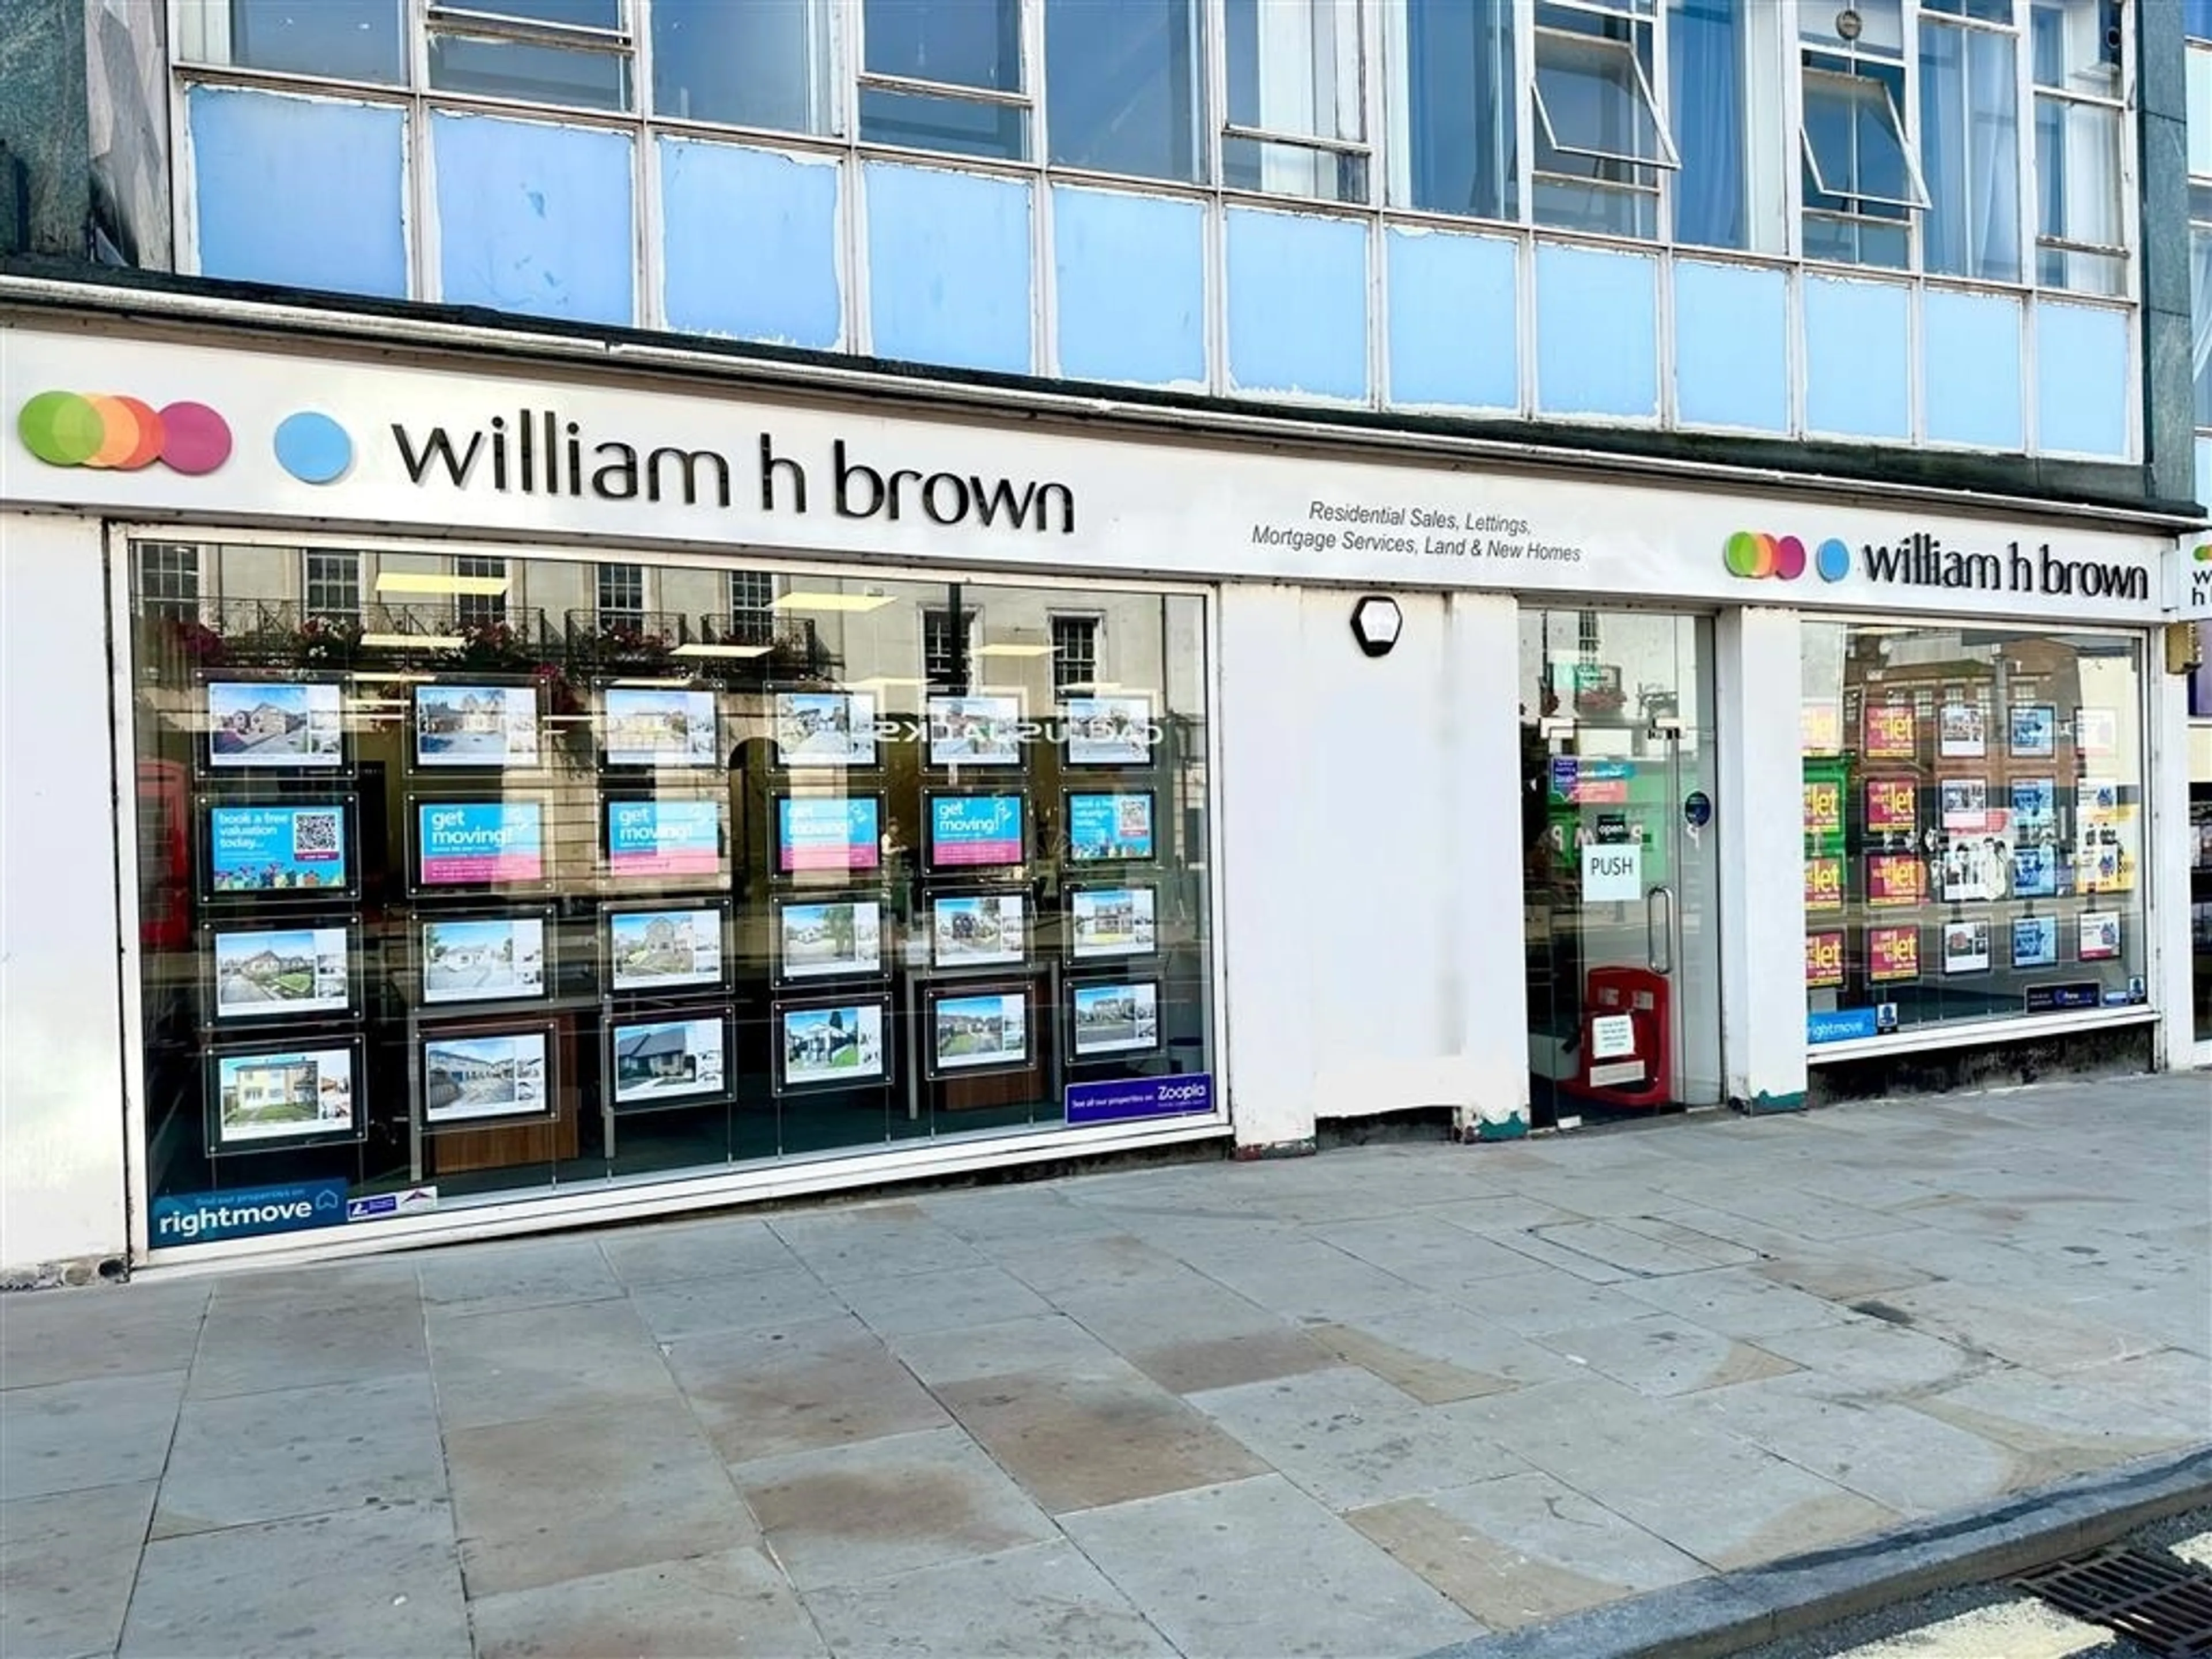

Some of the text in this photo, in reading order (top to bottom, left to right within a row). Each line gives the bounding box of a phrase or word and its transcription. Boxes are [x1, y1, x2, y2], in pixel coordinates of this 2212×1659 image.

[391, 408, 1074, 533] william h brown
[1309, 501, 1531, 536] Residential Sales, Lettings,
[1252, 525, 1581, 563] Mortgage Services, Land & New Homes
[1862, 532, 2149, 600] william h brown
[1889, 707, 1914, 740] let
[939, 800, 964, 819] get
[1812, 781, 1839, 816] let
[1891, 781, 1915, 814] let
[219, 813, 251, 824] book
[264, 812, 289, 824] free
[219, 825, 277, 835] valuation
[431, 809, 465, 830] get
[619, 808, 650, 825] get
[432, 825, 513, 847] moving!
[1590, 857, 1633, 876] PUSH
[1814, 860, 1839, 892] let
[1892, 857, 1916, 887] let
[1816, 937, 1842, 968] let
[1893, 930, 1917, 961] let
[1158, 1084, 1206, 1101] Zoopla
[160, 1201, 312, 1237] rightmove
